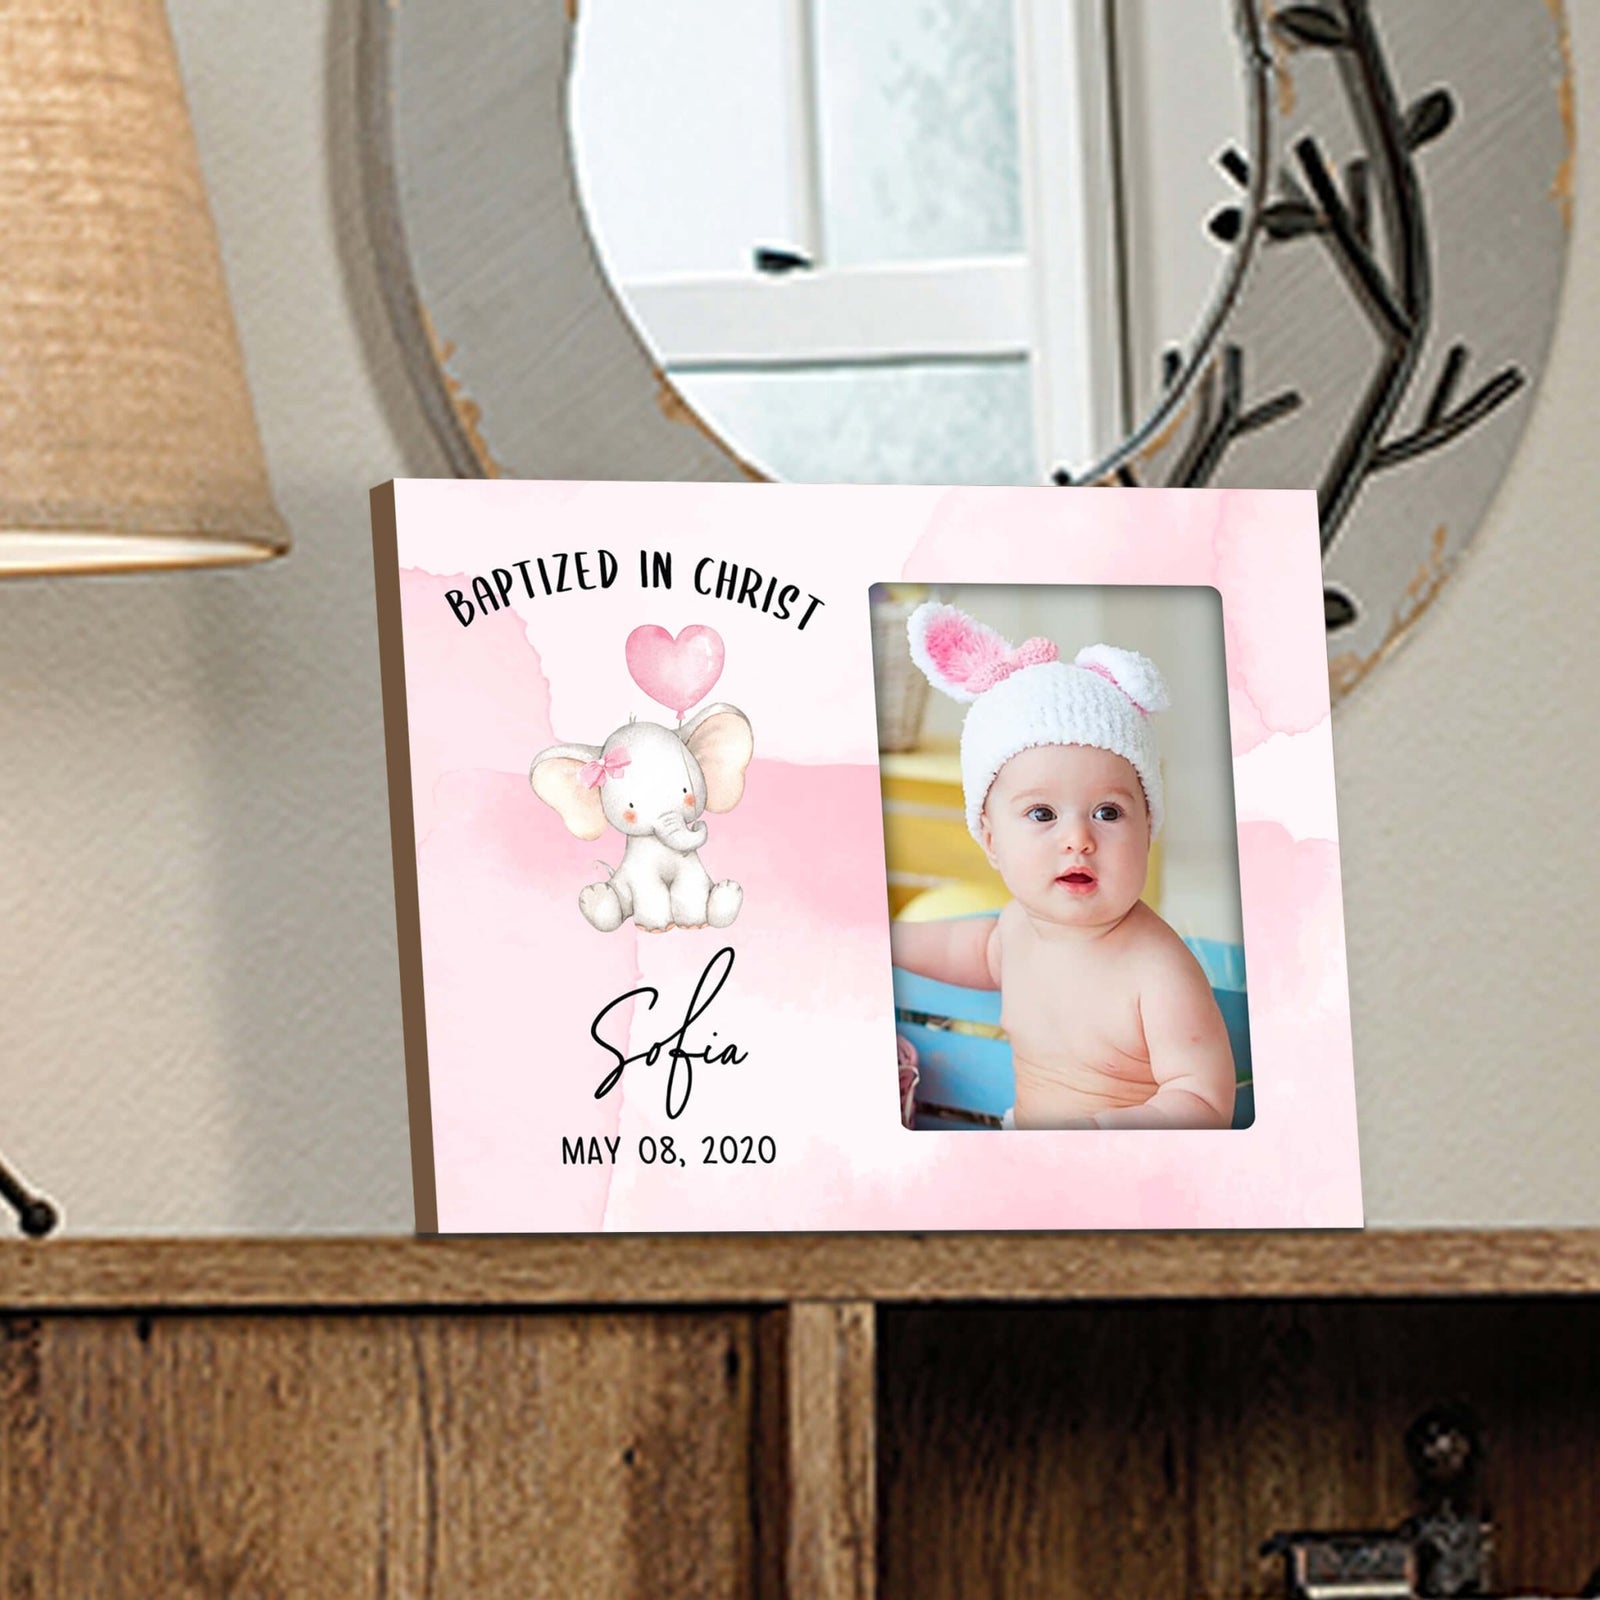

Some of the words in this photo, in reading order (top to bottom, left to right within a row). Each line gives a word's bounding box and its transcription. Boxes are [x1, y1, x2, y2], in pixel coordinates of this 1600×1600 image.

[444, 549, 618, 628] BAPTIZED
[640, 549, 672, 590] IN
[694, 557, 826, 632] CHRIST
[590, 946, 749, 1120] Sofia
[562, 1136, 621, 1165] MAY
[638, 1135, 686, 1168] 08,
[701, 1135, 777, 1165] 2020
